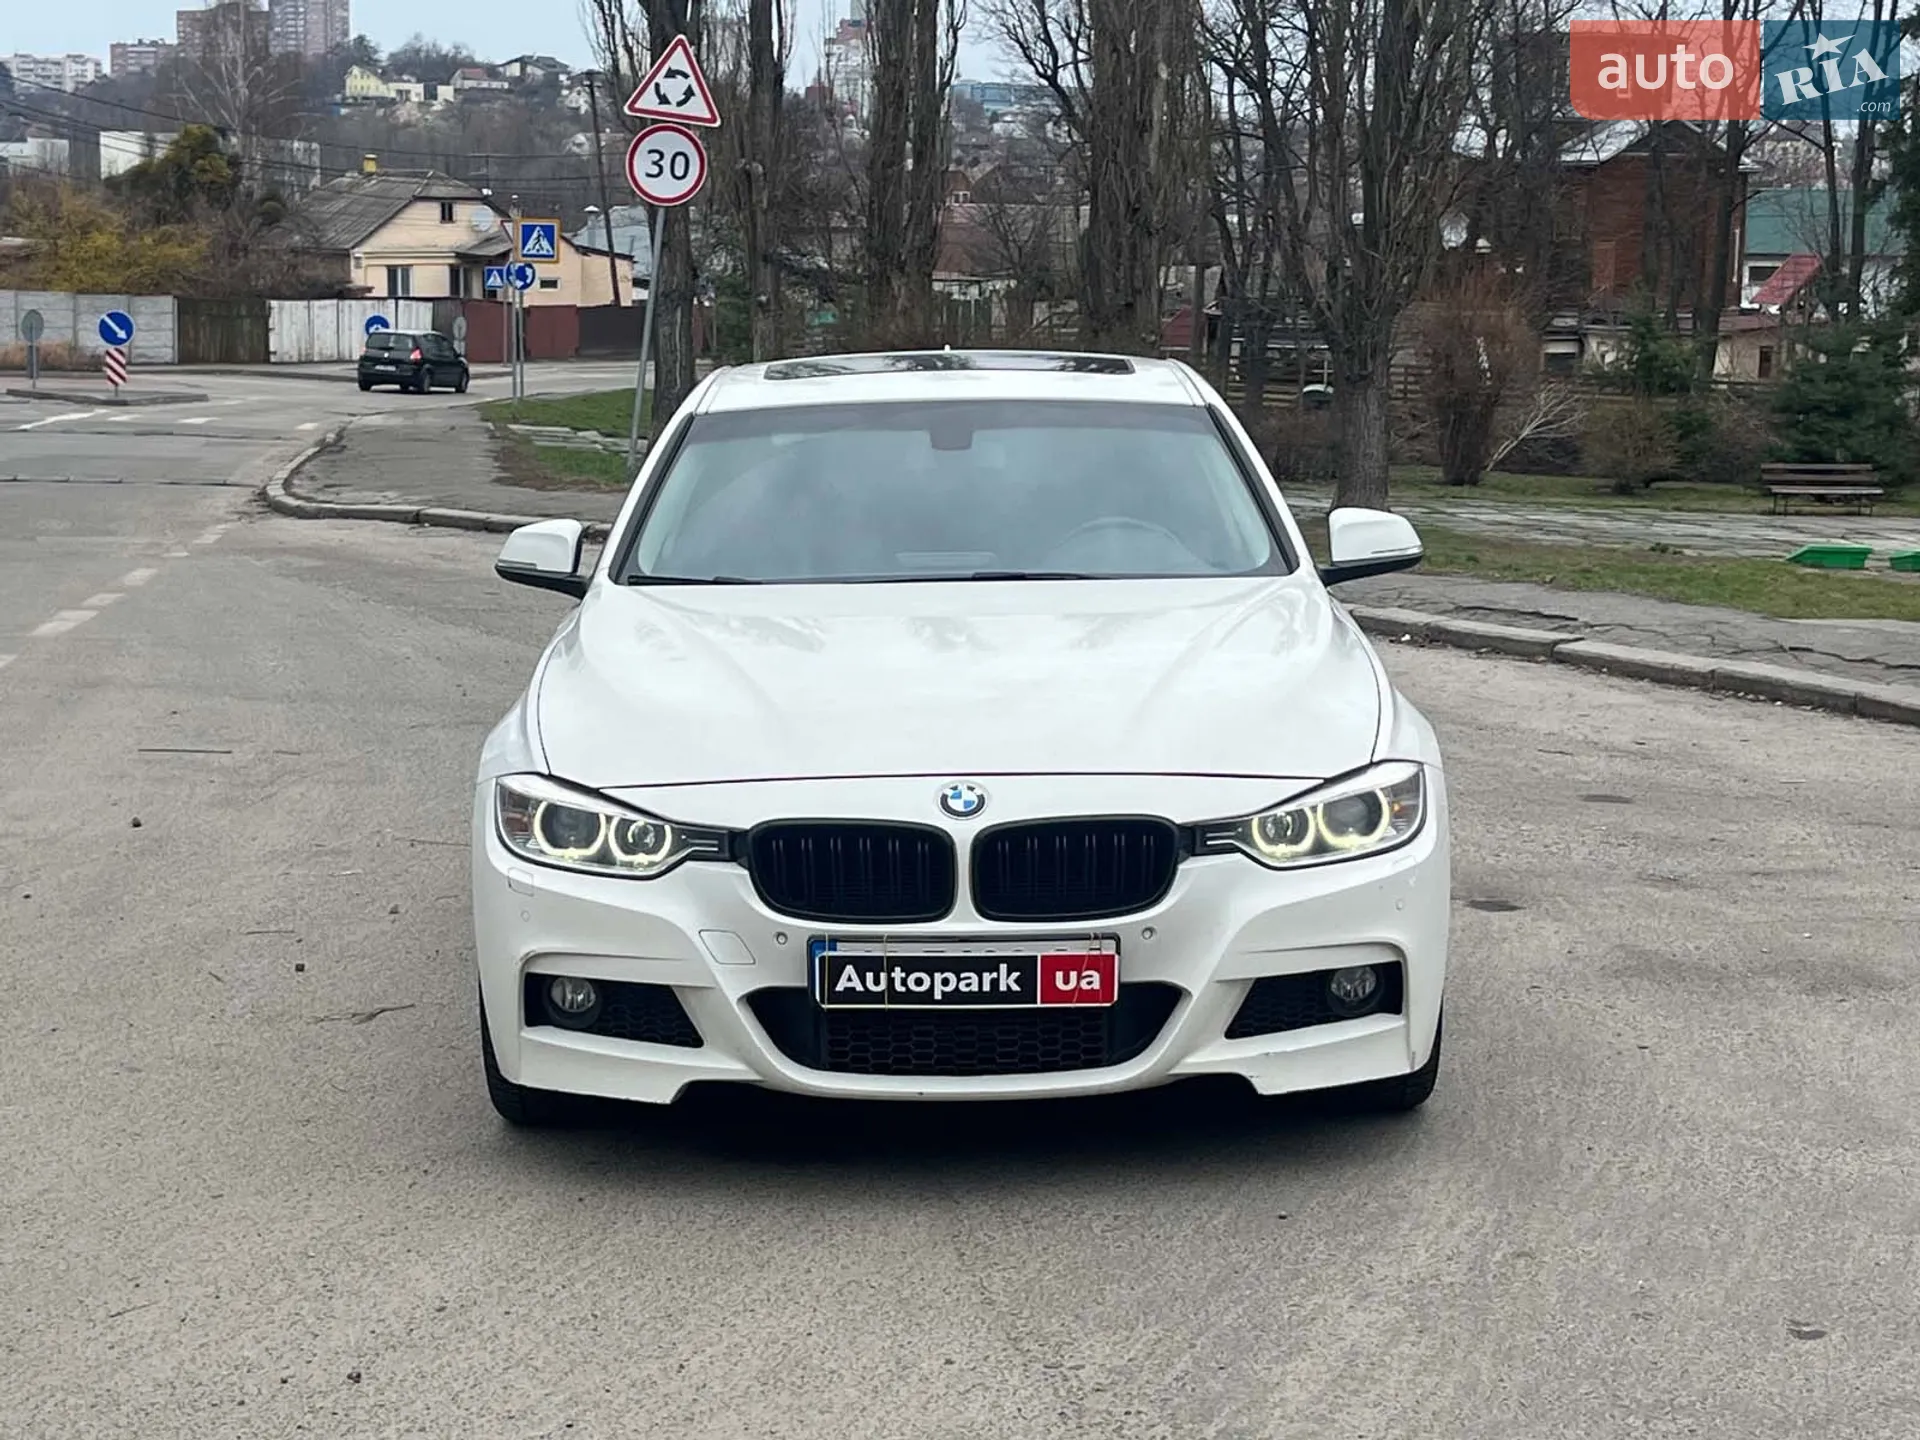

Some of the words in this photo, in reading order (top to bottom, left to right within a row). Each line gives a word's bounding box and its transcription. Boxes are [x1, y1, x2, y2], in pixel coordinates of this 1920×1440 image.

[645, 148, 690, 181] 30
[834, 963, 1022, 1000] Autopark
[1054, 969, 1101, 991] ua
